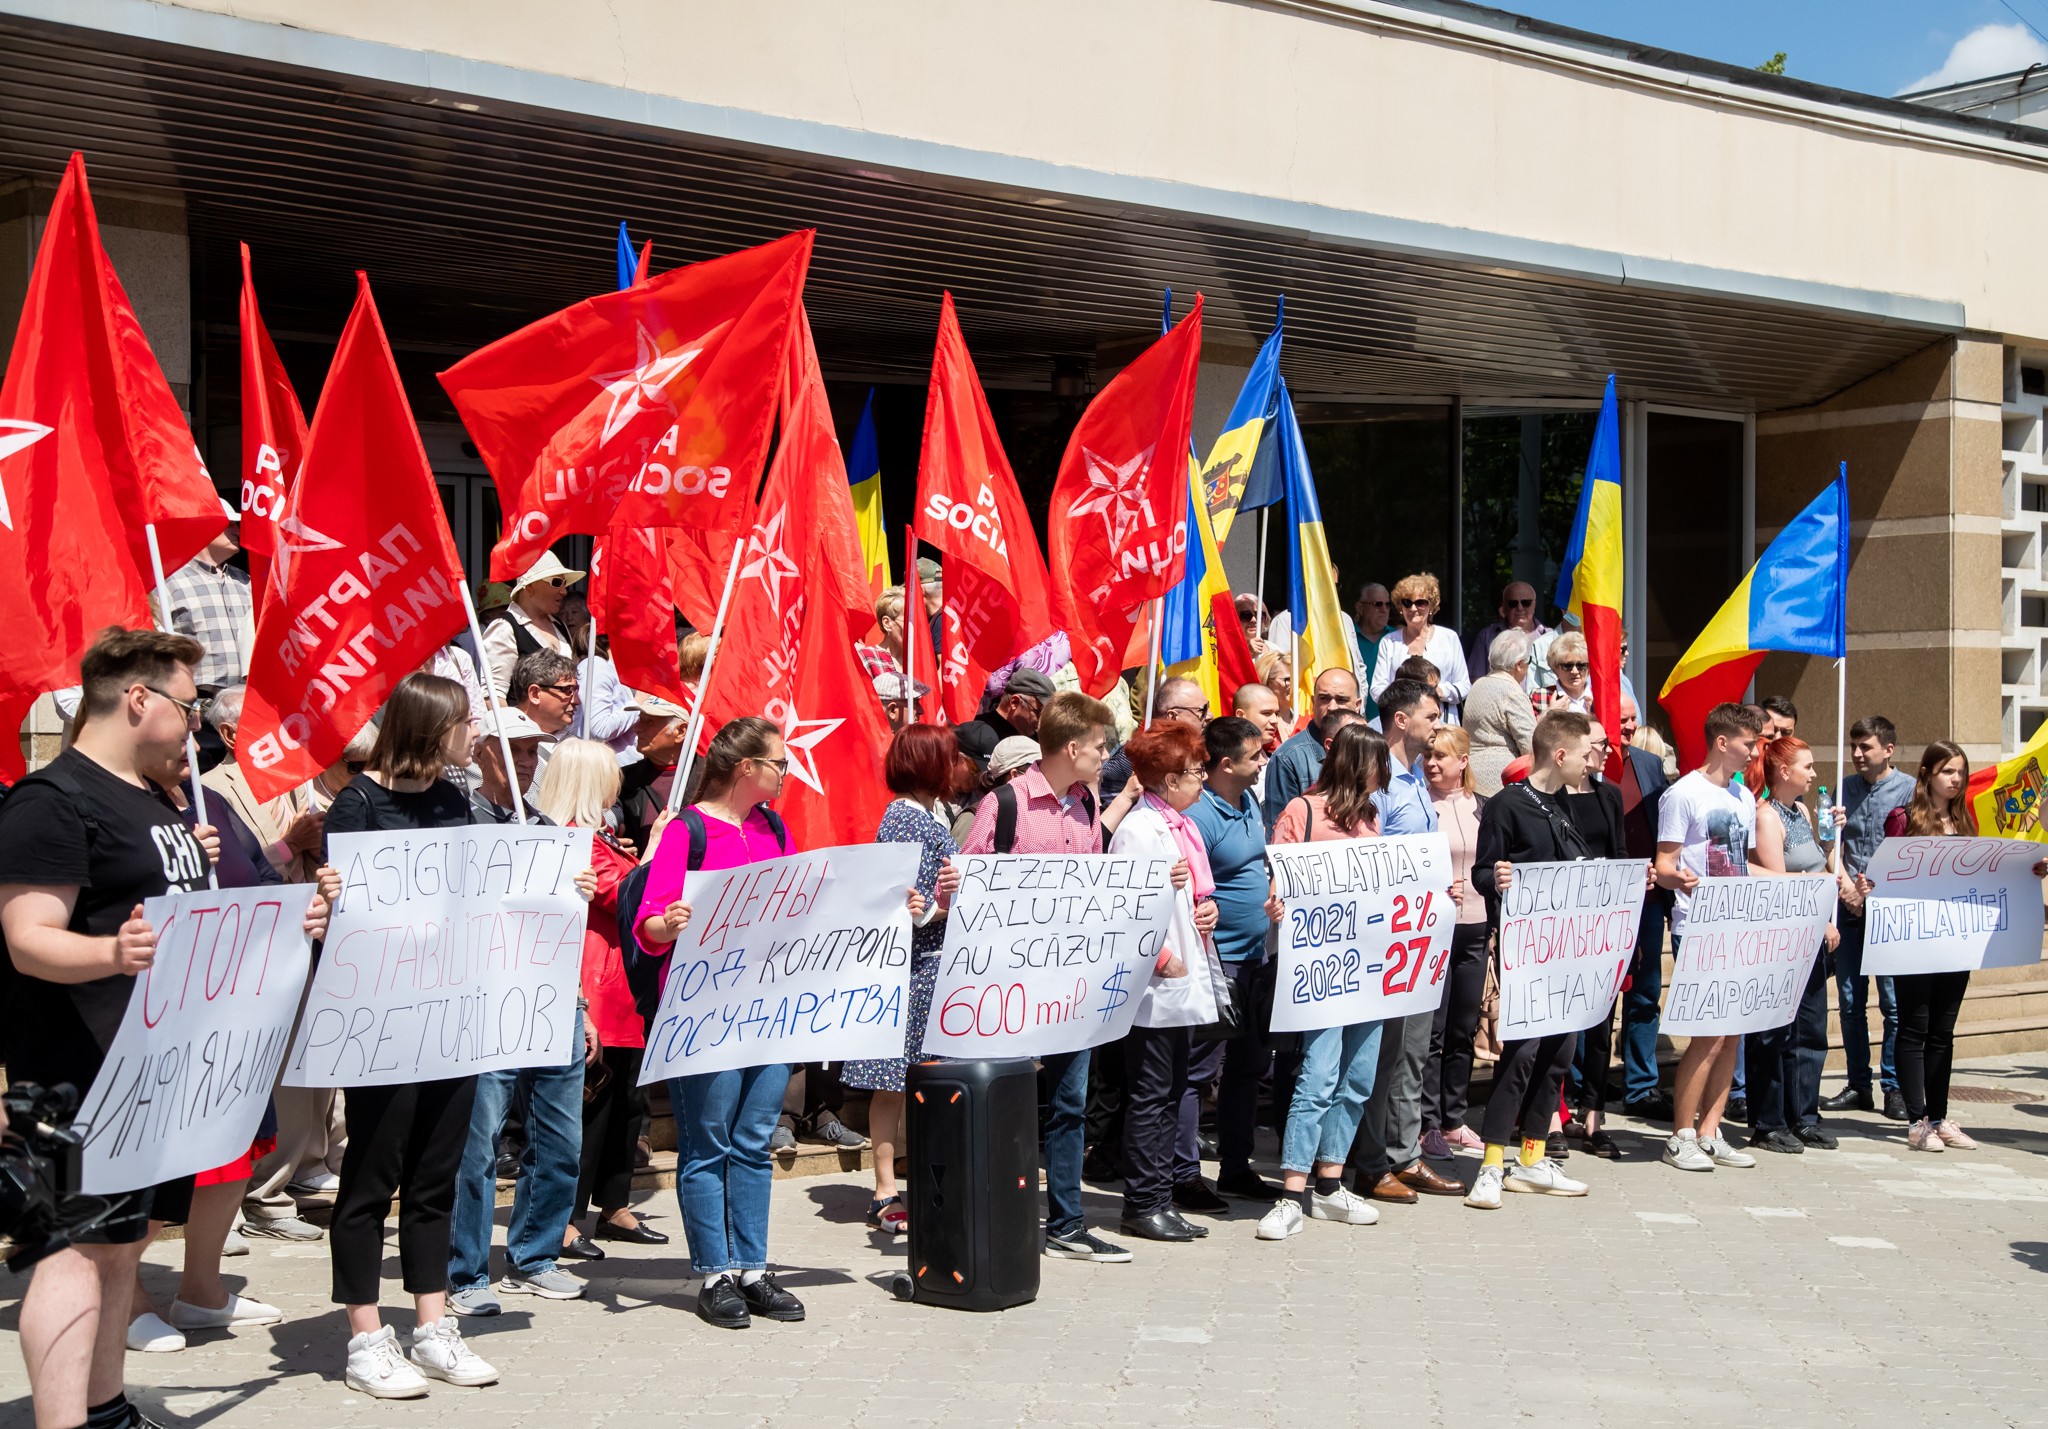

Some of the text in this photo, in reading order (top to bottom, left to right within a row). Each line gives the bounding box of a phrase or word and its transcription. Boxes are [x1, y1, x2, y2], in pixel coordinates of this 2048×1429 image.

[960, 857, 1167, 895] REZERVELE
[1886, 839, 2040, 882] STOP
[699, 860, 829, 955] ЦЕНЫ
[956, 893, 1158, 933] VALUTARE
[1504, 863, 1645, 918] ОБЕСПЕЧЬТЕ
[1690, 878, 1826, 924] НАЦБАНК
[946, 945, 992, 977] AU
[1137, 928, 1168, 958] CU
[1291, 900, 1357, 949] 2021
[1501, 910, 1635, 971] СТАБИЛЬНОСТЬ
[1680, 924, 1817, 973] ПОД КОНТРОЛЬ
[143, 901, 282, 1030] СТОП
[326, 910, 582, 1000] STABILITATEA
[657, 925, 907, 1013] ПОД КОНТРОЛЬ
[1292, 948, 1361, 1005] 2022
[645, 983, 901, 1072] ГОСУДАРСТВА
[939, 961, 1132, 1038] 600 mil. $
